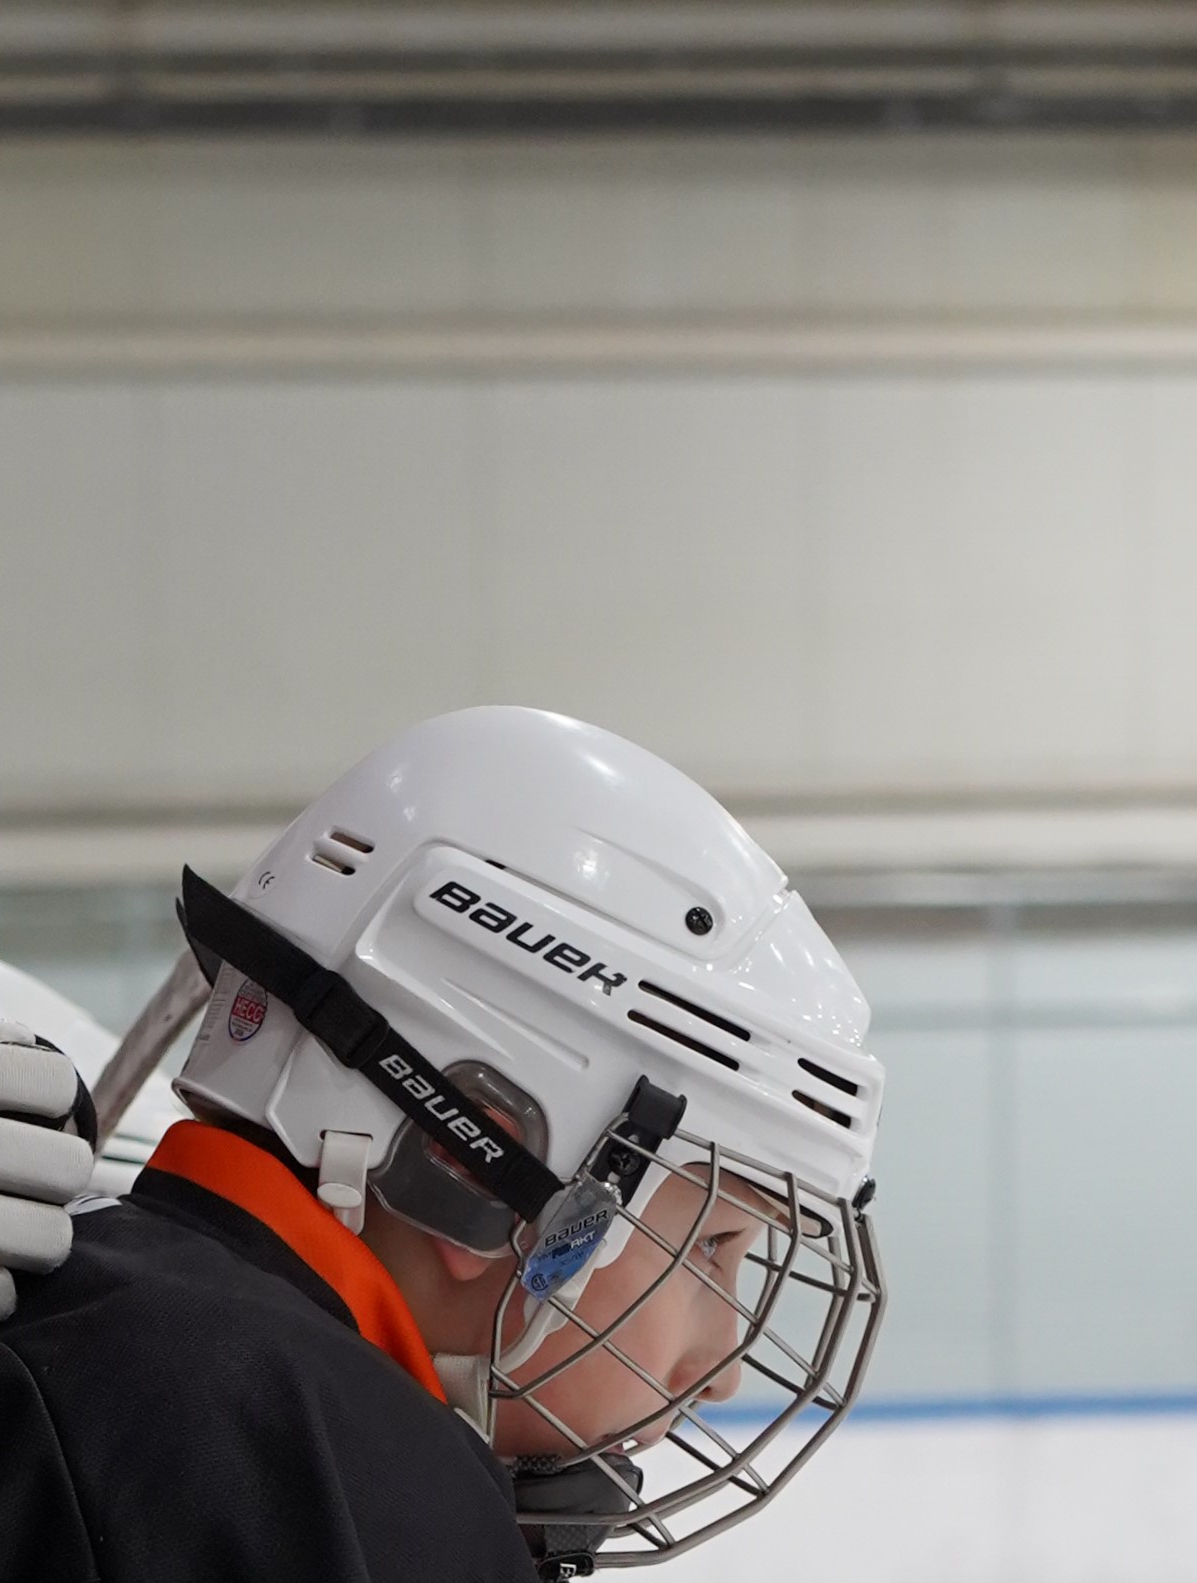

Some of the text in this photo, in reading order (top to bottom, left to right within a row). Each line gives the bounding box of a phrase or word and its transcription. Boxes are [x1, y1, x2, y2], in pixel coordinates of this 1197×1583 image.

[428, 880, 629, 997] BAUER
[378, 1053, 505, 1165] BAUER
[544, 1208, 609, 1247] BAUER
